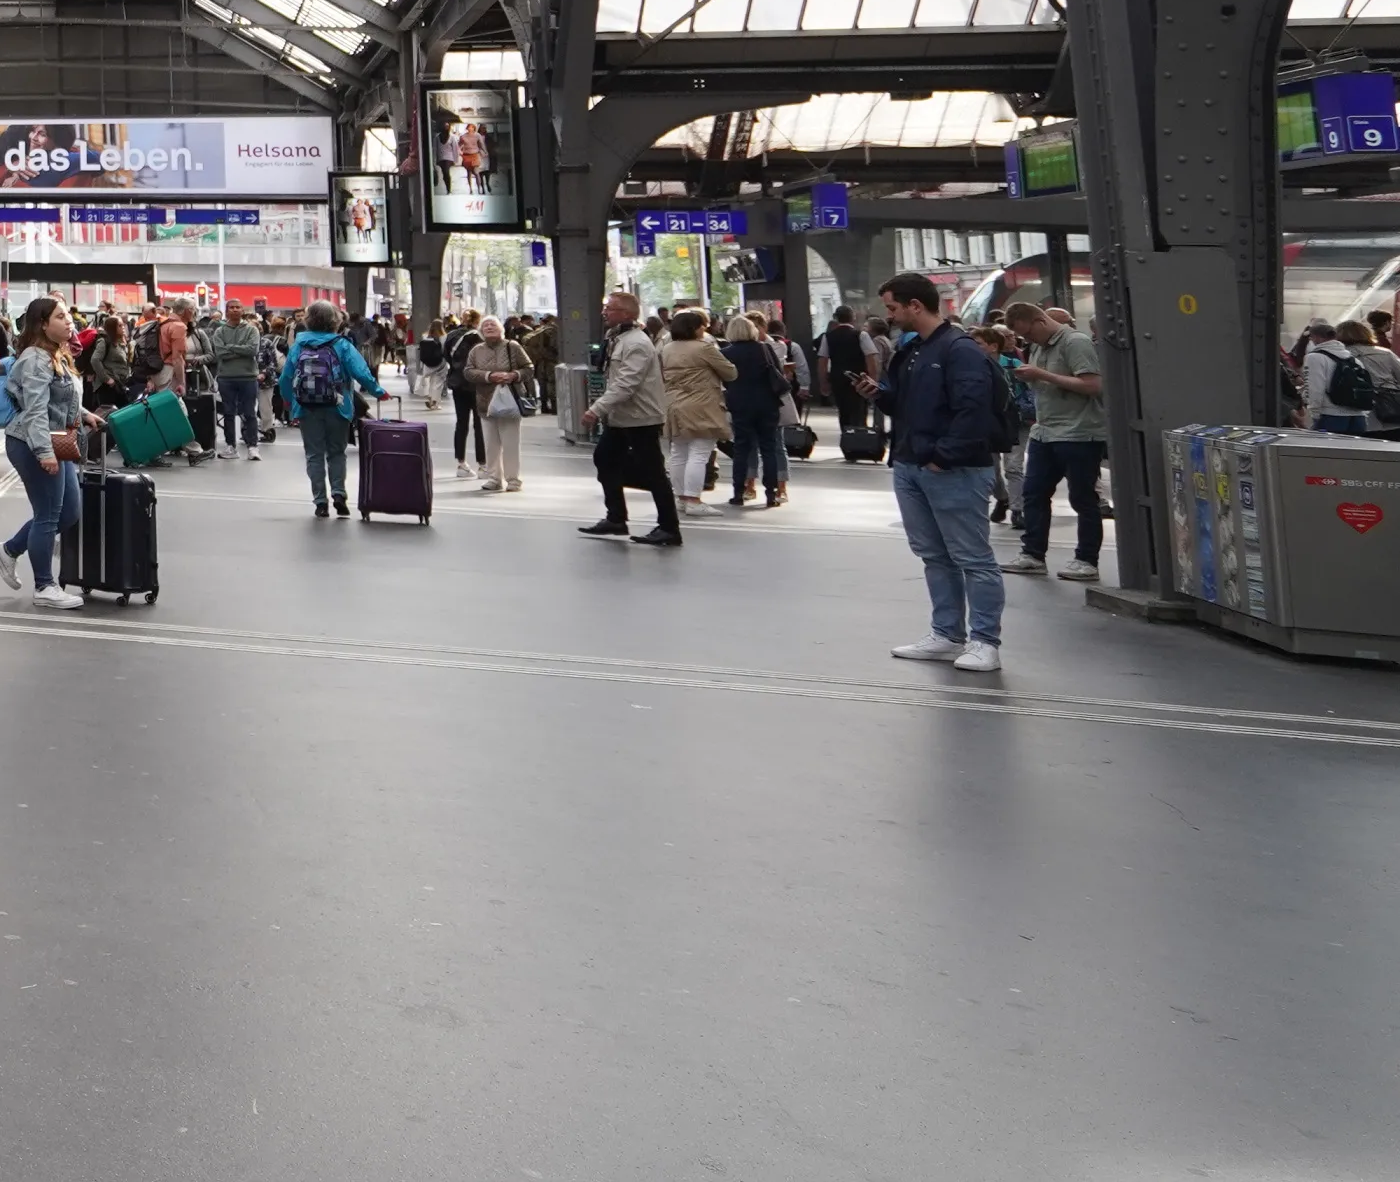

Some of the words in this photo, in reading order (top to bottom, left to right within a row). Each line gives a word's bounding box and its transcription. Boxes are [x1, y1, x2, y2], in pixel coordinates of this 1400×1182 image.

[1329, 131, 1338, 148] 9
[1364, 128, 1382, 146] 9
[4, 141, 70, 172] das
[79, 141, 204, 172] Leben.
[238, 143, 321, 158] Helsana
[88, 214, 98, 222] 21
[104, 214, 114, 222] 22
[670, 220, 686, 230] 21
[709, 220, 728, 231] 34
[830, 214, 840, 224] 7
